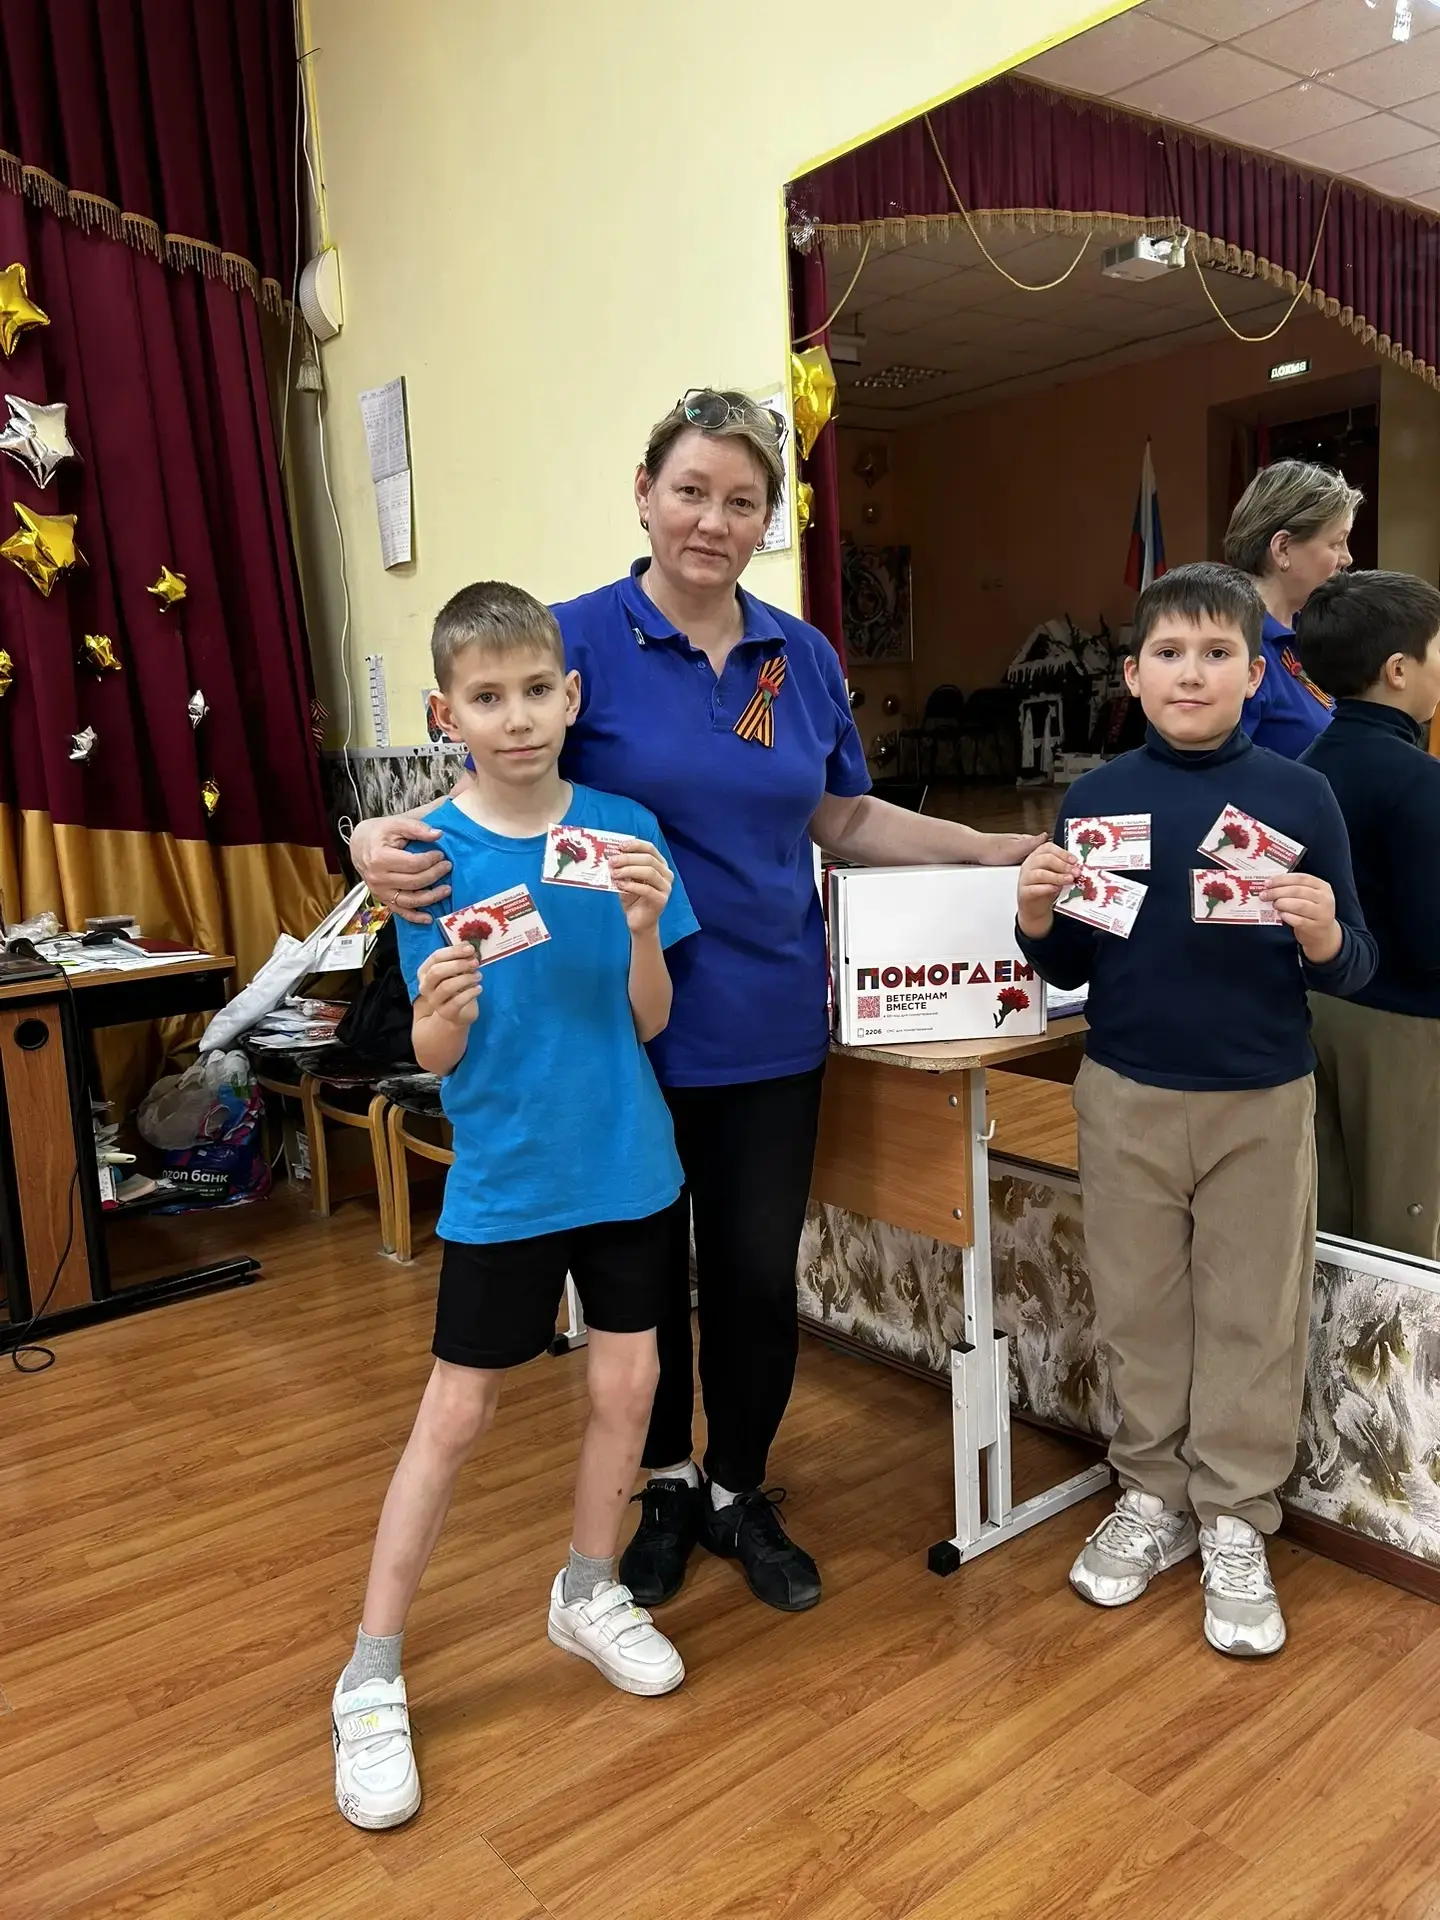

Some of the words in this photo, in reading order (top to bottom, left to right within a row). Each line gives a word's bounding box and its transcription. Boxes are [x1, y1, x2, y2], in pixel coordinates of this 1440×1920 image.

[857, 960, 1034, 991] ПОМОГАЕМ
[886, 992, 948, 1003] ВЕТЕРАНАМ
[886, 1002, 927, 1011] ВМЕСТЕ
[191, 1169, 229, 1183] банк
